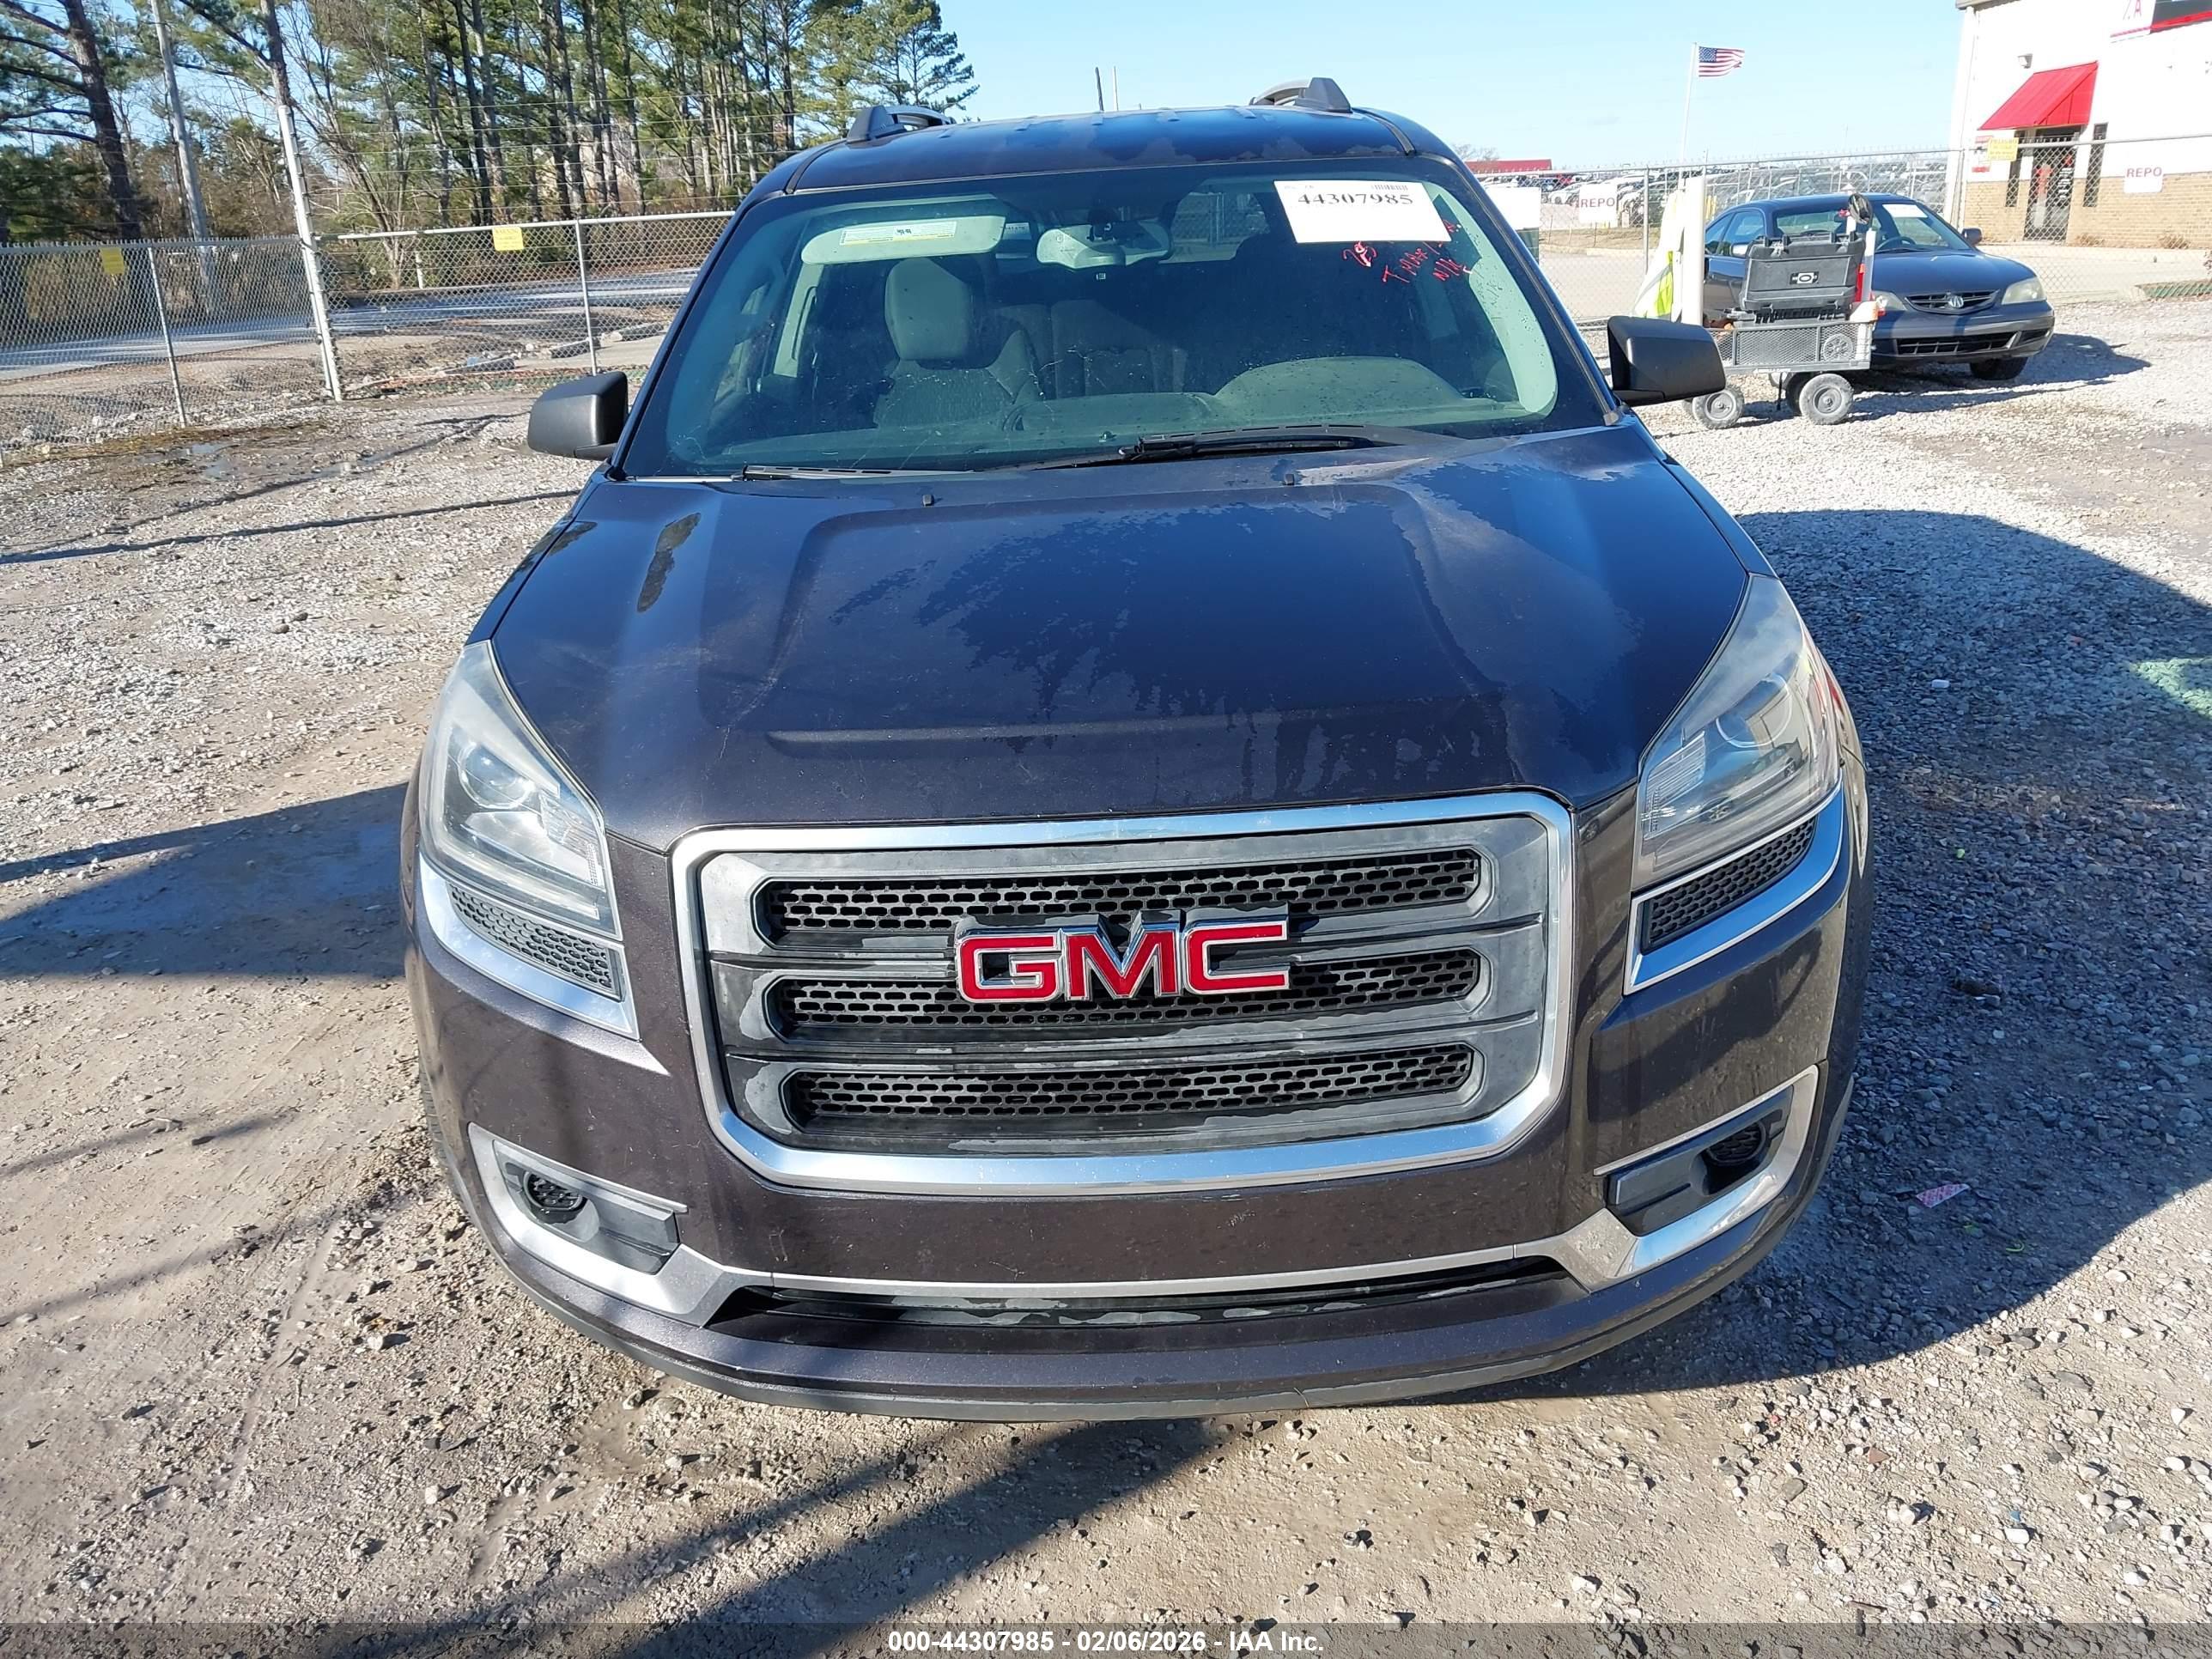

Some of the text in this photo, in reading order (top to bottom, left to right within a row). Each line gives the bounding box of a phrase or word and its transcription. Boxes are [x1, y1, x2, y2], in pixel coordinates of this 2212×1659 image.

[2126, 167, 2162, 178] REPO
[1297, 193, 1413, 204] 44307985
[1581, 198, 1615, 208] REPO
[956, 910, 1291, 1004] GMC
